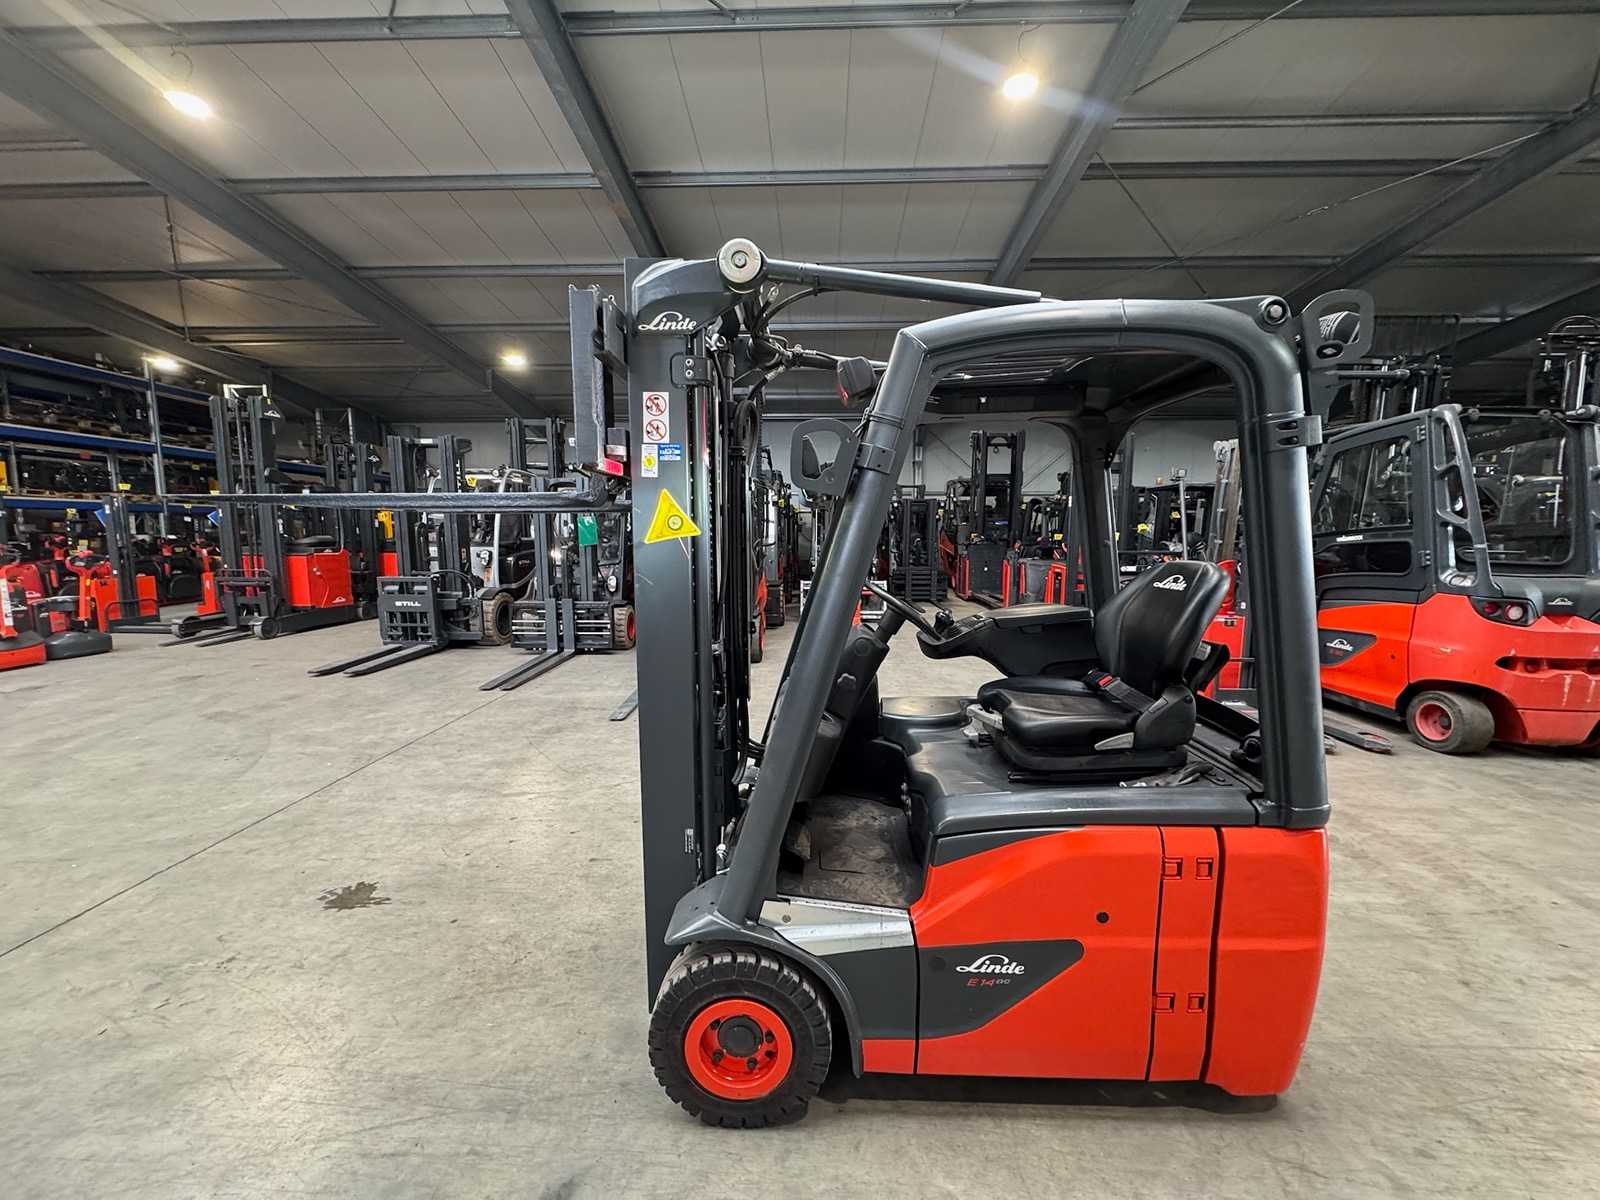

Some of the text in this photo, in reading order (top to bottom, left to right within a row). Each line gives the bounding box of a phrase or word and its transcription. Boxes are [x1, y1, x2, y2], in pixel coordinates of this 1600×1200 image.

[638, 311, 697, 331] Linde
[1153, 574, 1187, 591] Linde
[1326, 638, 1353, 652] Linde
[956, 954, 1025, 975] Linde
